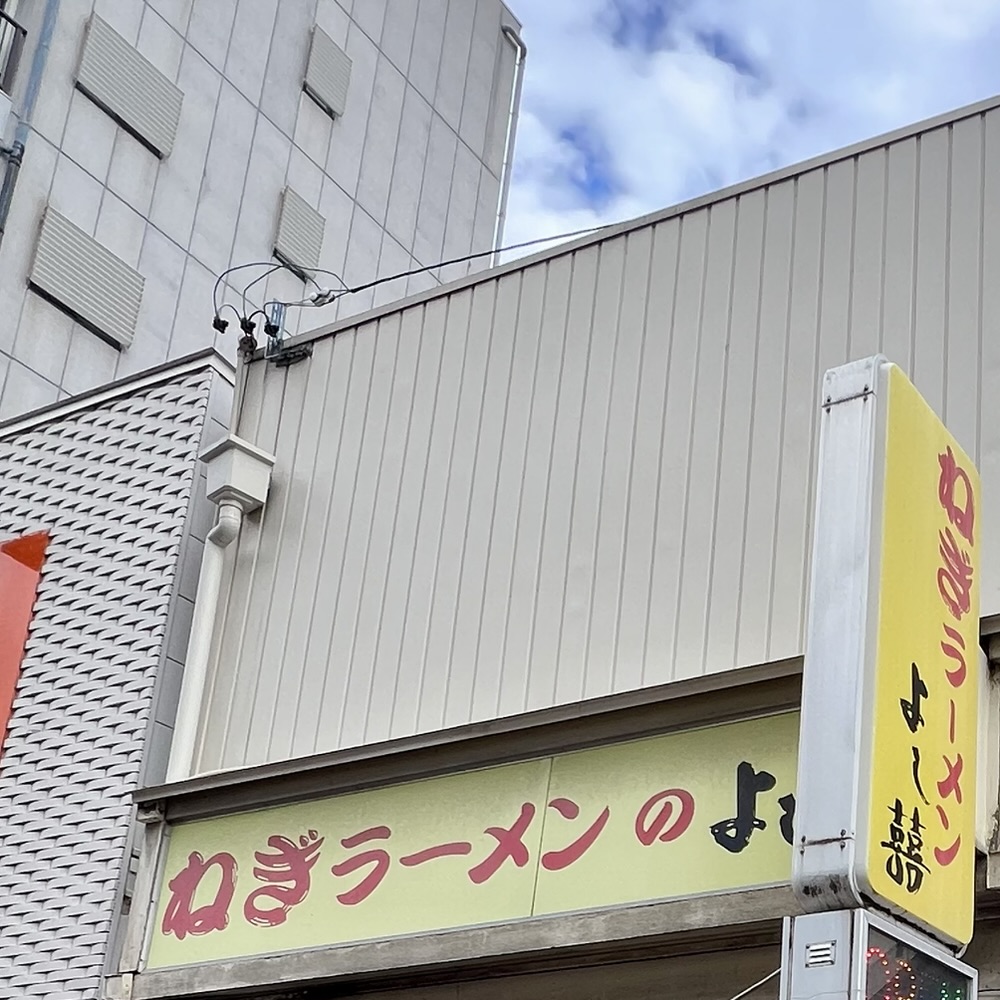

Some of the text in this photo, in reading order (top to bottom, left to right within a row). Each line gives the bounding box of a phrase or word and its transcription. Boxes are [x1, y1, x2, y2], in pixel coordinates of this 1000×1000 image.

[934, 445, 974, 867] ねぎラーメン
